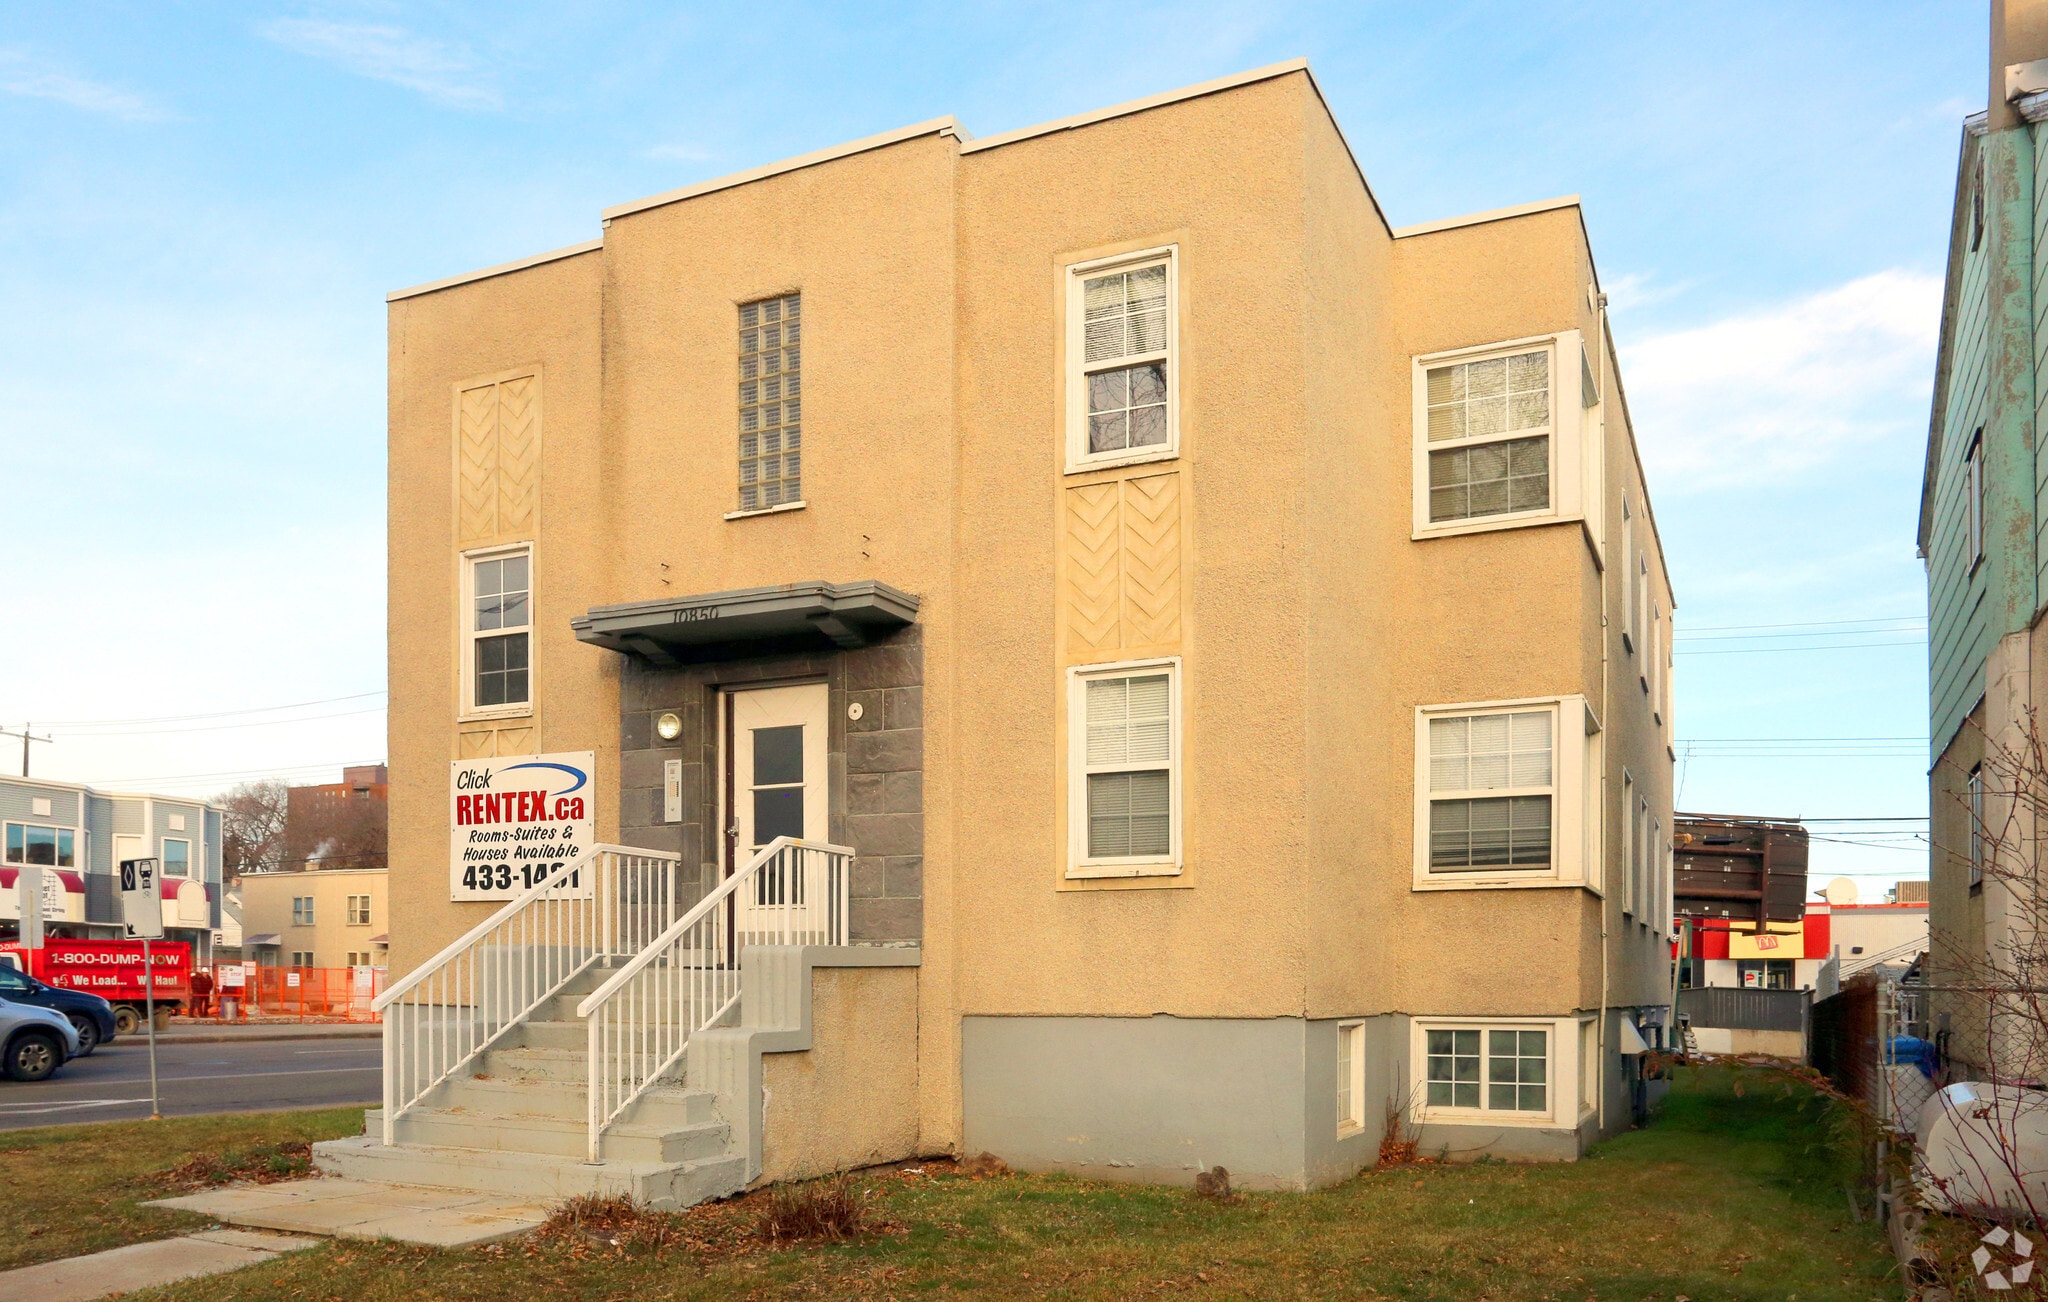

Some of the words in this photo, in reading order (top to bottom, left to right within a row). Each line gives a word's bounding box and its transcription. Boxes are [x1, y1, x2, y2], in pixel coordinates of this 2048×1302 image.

[673, 606, 719, 624] 10850
[457, 768, 493, 789] Click
[456, 790, 584, 825] RENTEX.ca
[469, 826, 557, 843] Rooms-Suites
[562, 825, 573, 839] &
[463, 846, 509, 862] Houses
[513, 843, 579, 860] Available
[72, 975, 89, 986] We
[92, 975, 127, 986] Load...
[155, 975, 178, 986] Haul
